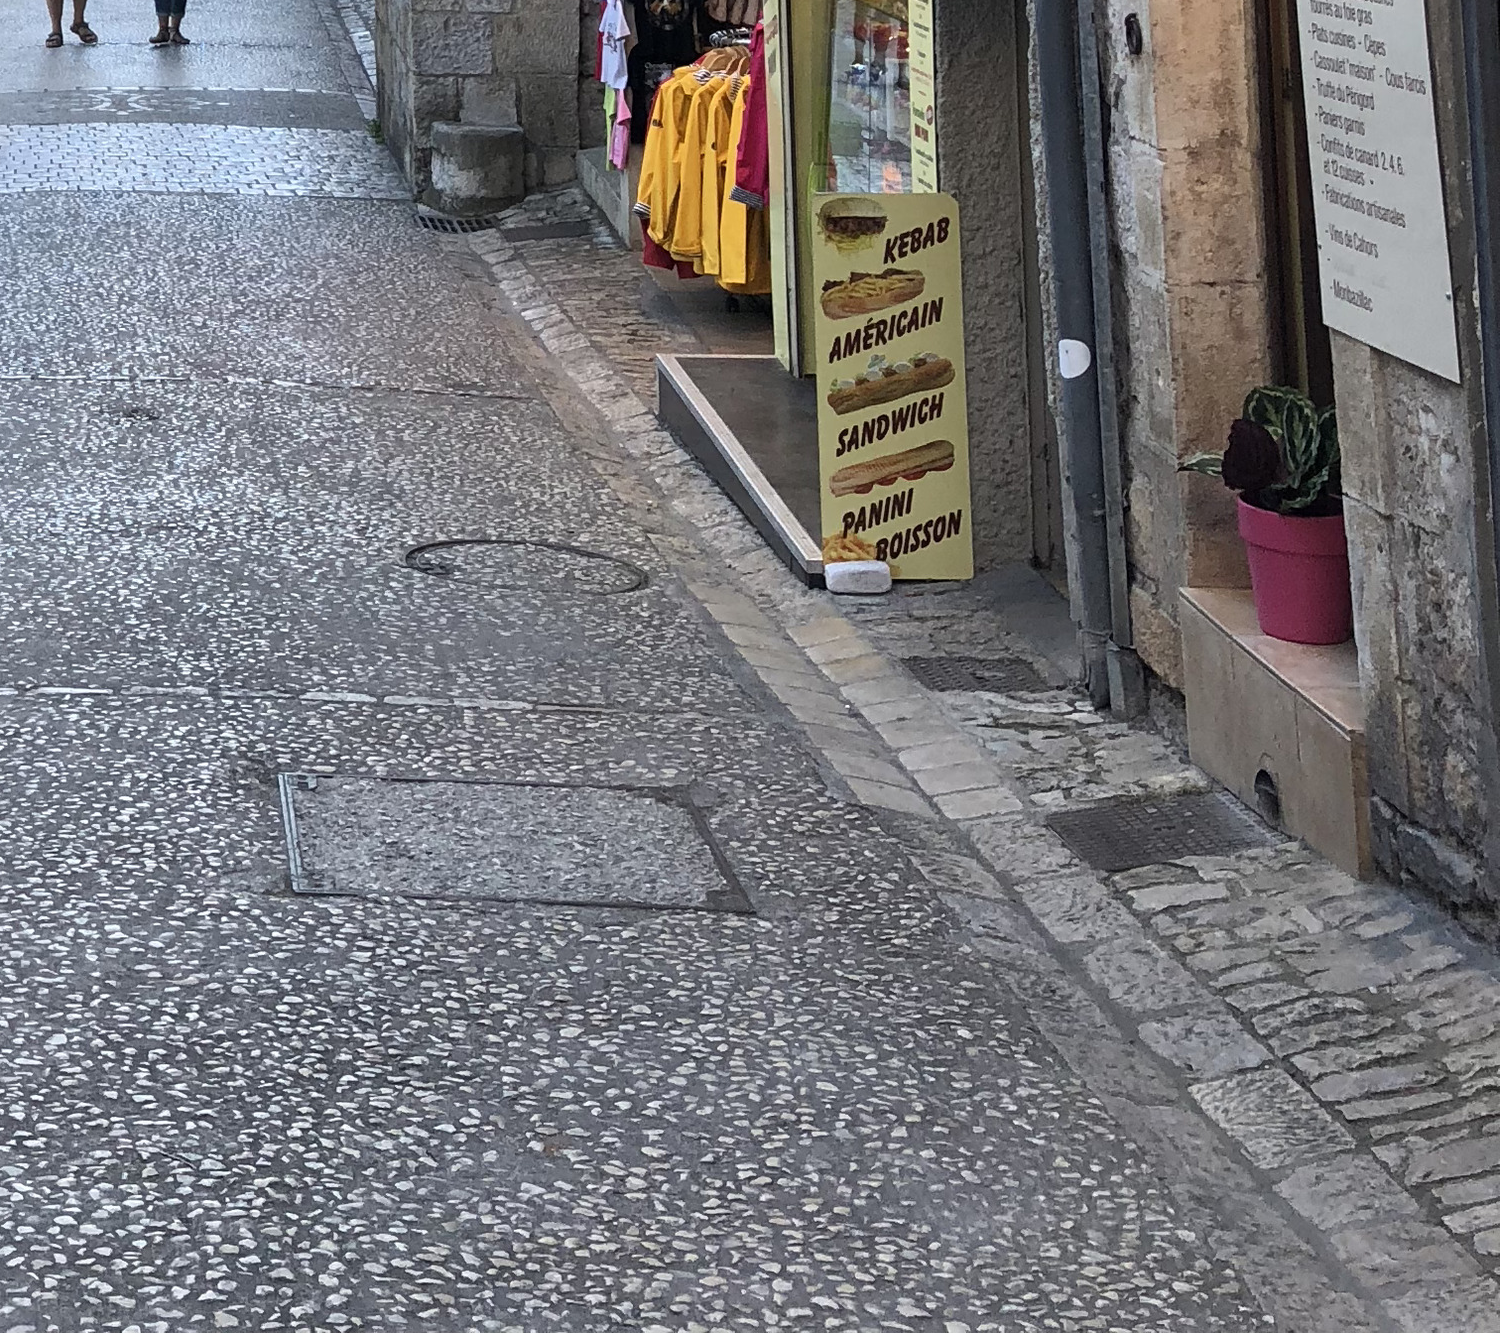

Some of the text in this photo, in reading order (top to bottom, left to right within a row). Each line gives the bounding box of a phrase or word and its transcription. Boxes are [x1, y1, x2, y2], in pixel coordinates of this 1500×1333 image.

[1357, 8, 1373, 26] gras
[1314, 50, 1346, 75] Cassoulet
[1345, 141, 1354, 160] de
[1354, 147, 1379, 168] canard
[883, 217, 950, 264] KEBAB
[828, 297, 944, 364] AMÉRICAIN
[836, 392, 944, 457] SANDWICH
[842, 488, 914, 538] PANINI
[875, 509, 962, 561] BOISSON
